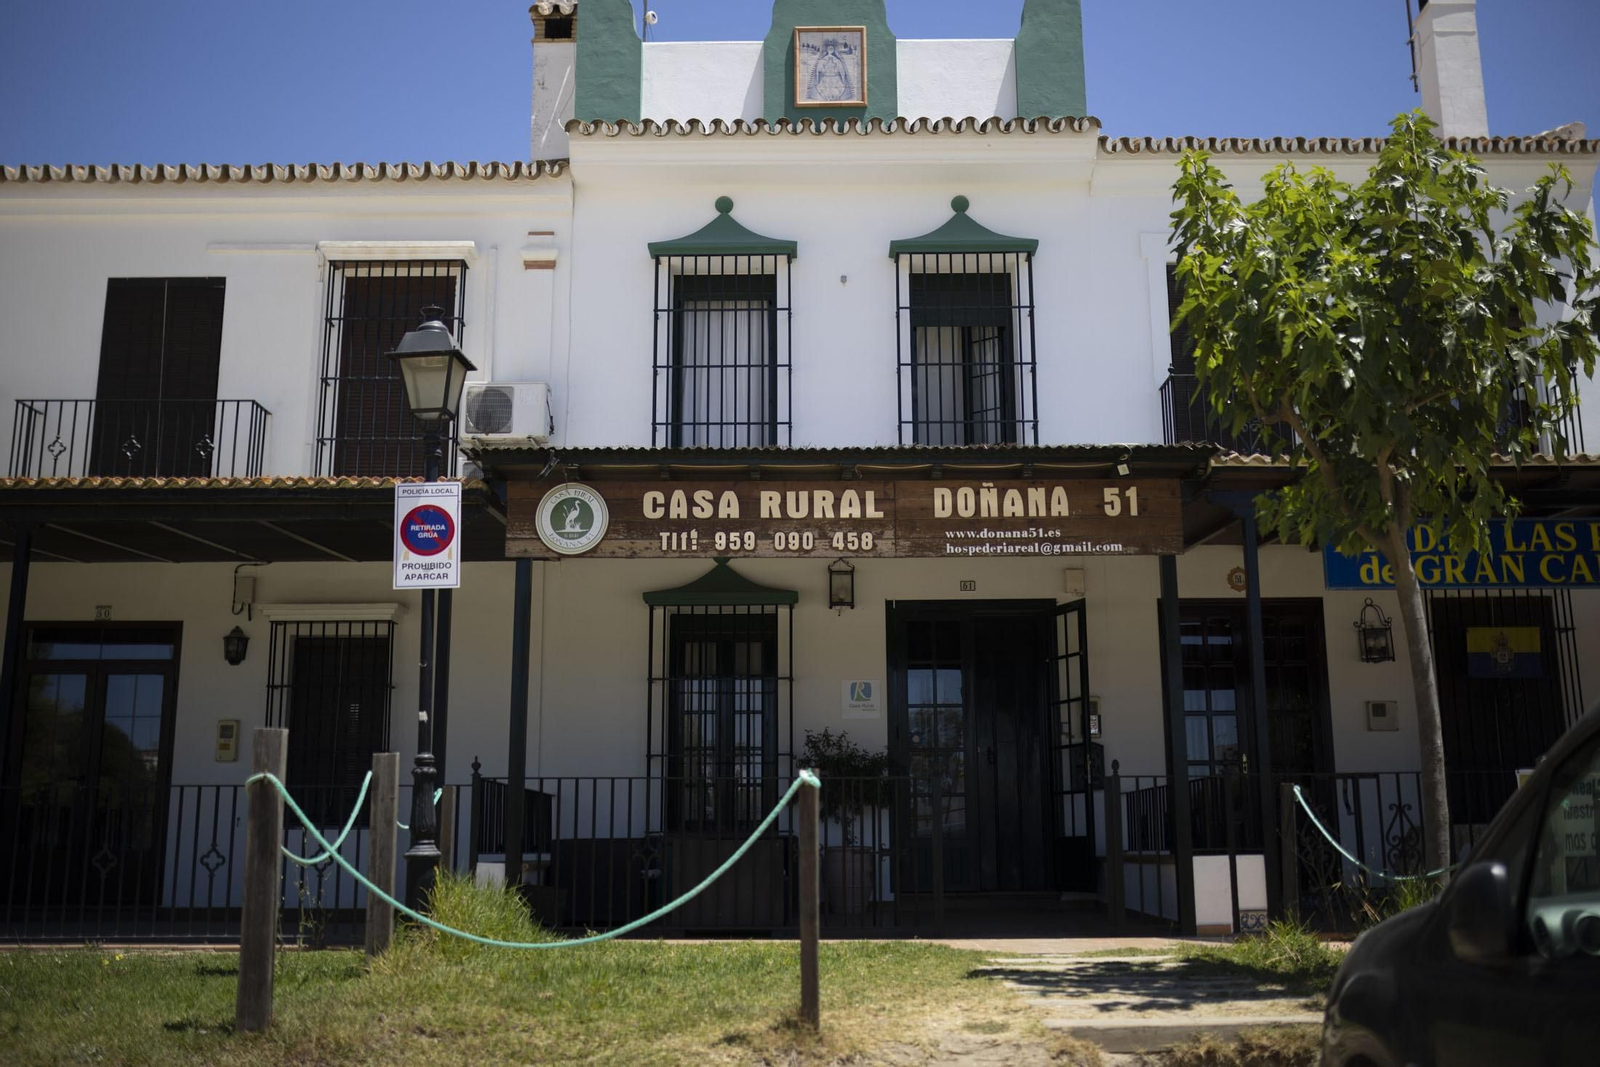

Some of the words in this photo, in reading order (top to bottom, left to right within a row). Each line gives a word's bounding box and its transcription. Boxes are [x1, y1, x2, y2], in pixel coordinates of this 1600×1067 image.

[550, 489, 571, 504] CASA
[642, 489, 740, 519] CASA
[760, 489, 884, 519] RURAL
[933, 482, 1070, 518] DOÑANA
[1103, 486, 1138, 516] 51
[417, 530, 438, 538] GRÚA
[714, 531, 756, 551] 959
[774, 531, 814, 550] 090
[832, 531, 874, 550] 458
[945, 528, 1061, 538] www.donana51.es
[1502, 522, 1578, 552] LAS
[946, 541, 1123, 556] hospederiareal@gmail.com
[402, 562, 452, 570] PROHIBIDO
[1414, 554, 1526, 584] GRAN
[1539, 554, 1600, 584] CA
